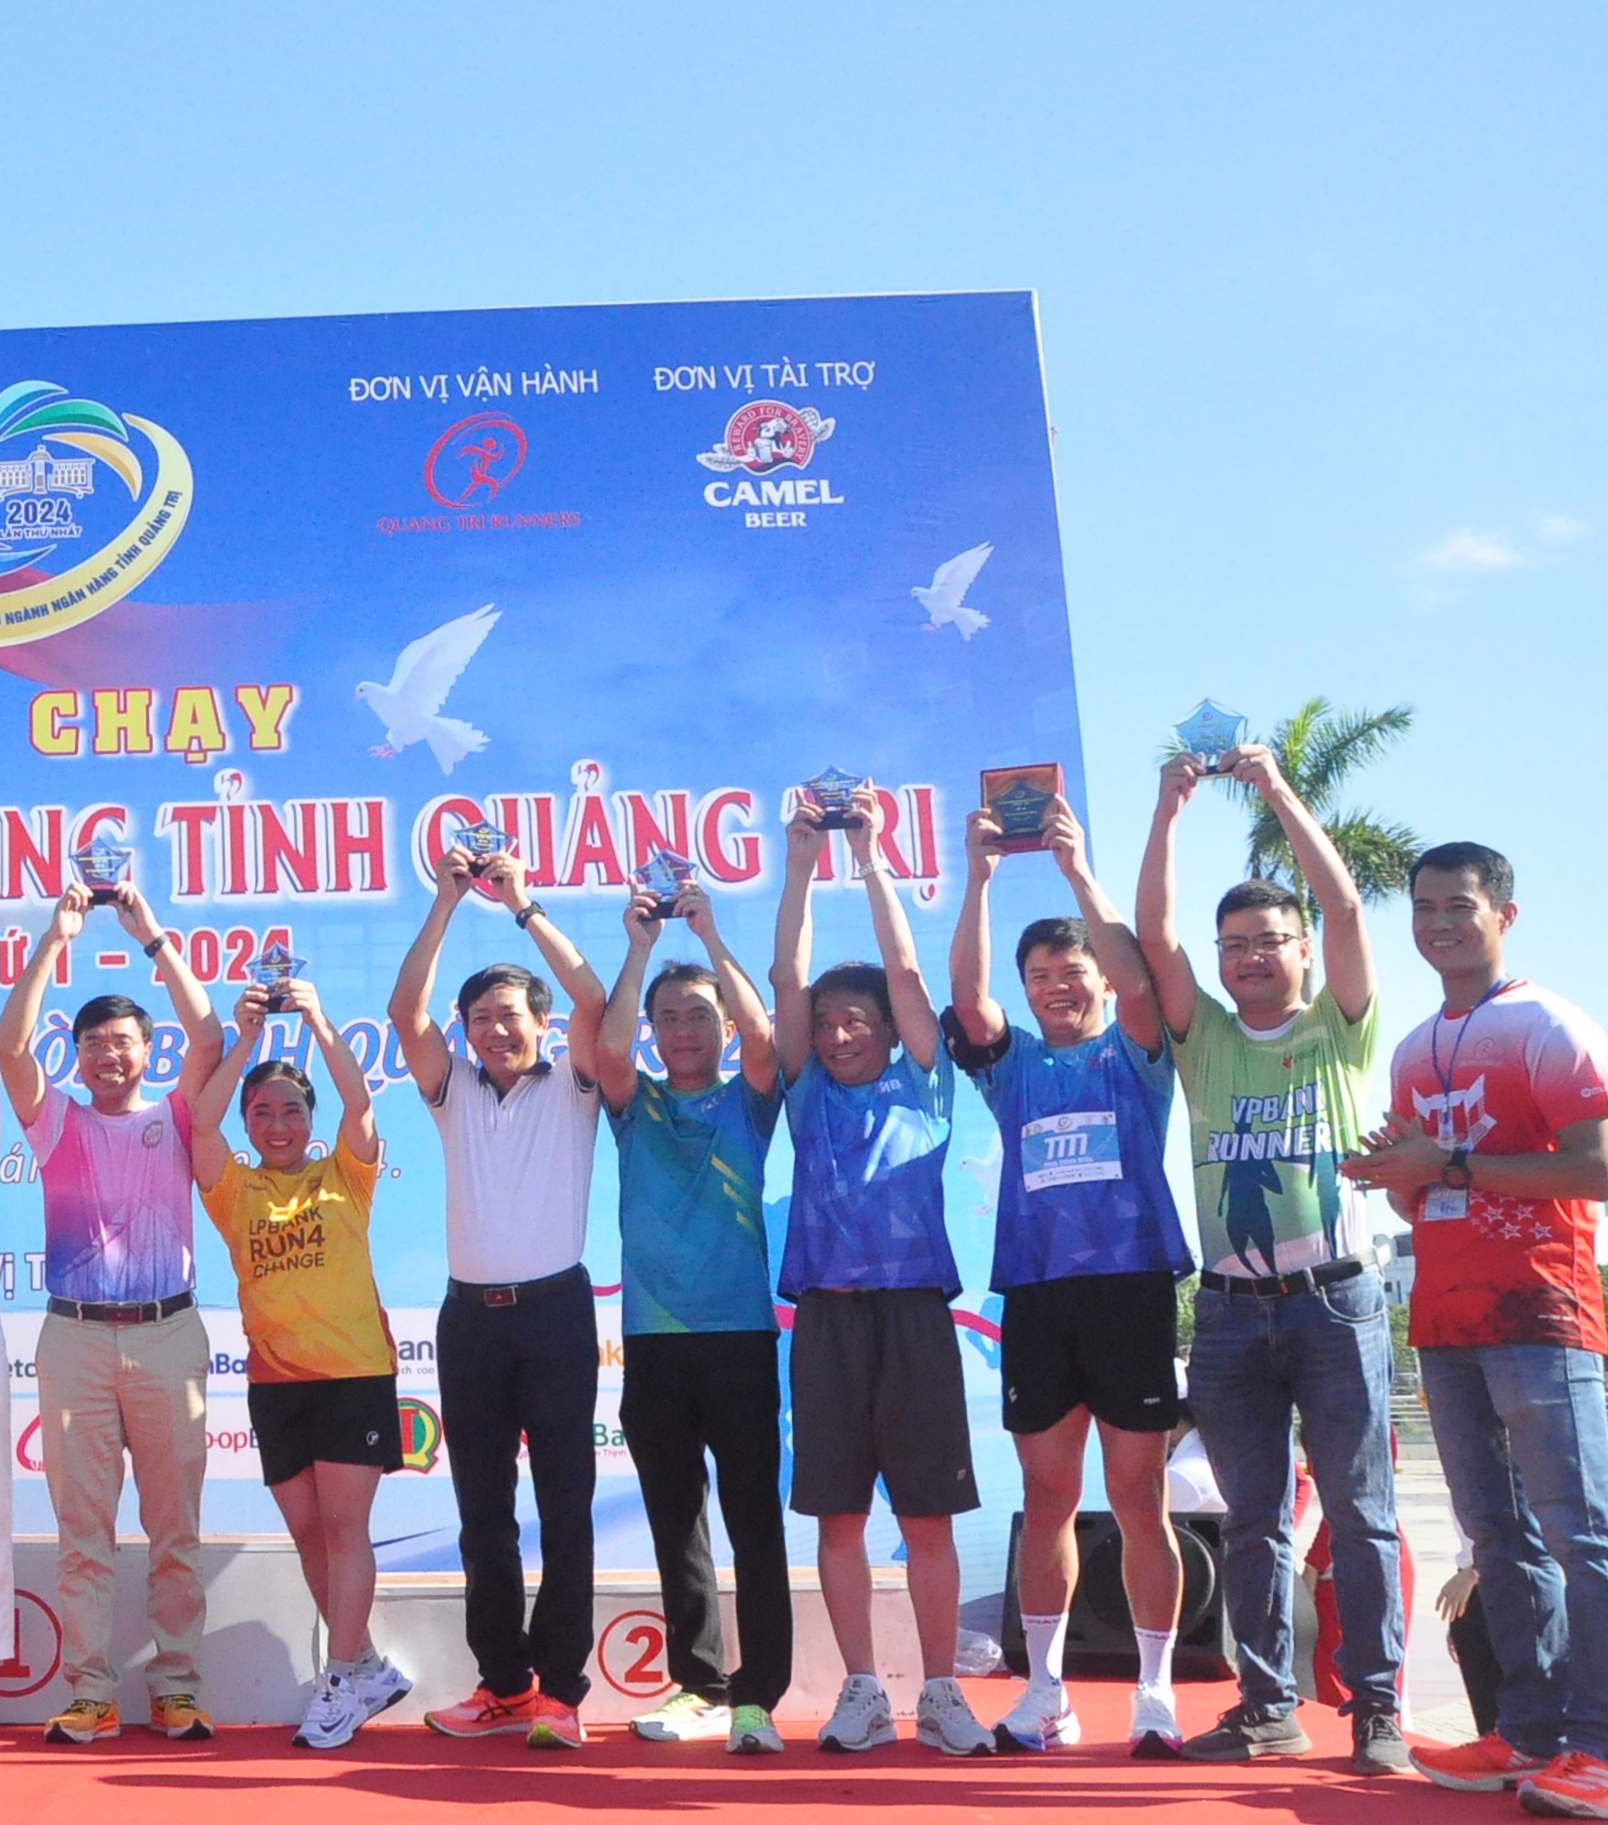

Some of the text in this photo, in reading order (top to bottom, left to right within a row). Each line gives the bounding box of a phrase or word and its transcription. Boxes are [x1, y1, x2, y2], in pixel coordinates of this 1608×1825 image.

[349, 363, 599, 403] ĐƠN VỊ VẬN HÀNH
[653, 356, 875, 394] ĐƠN VỊ TÀI TRỢ
[759, 404, 783, 419] FOR
[7, 500, 71, 525] 2024
[704, 480, 844, 507] CAMEL
[745, 512, 807, 528] BEER
[6, 604, 50, 625] NGÀNH
[51, 587, 87, 613] NGÂN
[87, 567, 120, 596] HÀNG
[114, 544, 142, 571] TỈNH
[138, 507, 173, 547] QUẢNG
[163, 490, 183, 510] TRỊ
[30, 684, 293, 763] CHẠY
[159, 773, 387, 896] TỈNH
[1207, 1120, 1333, 1162] RUNNER
[249, 1206, 324, 1236] LPBANK
[249, 1224, 326, 1262] RUN4
[254, 1251, 325, 1279] CHANGE
[624, 1626, 664, 1683] 2
